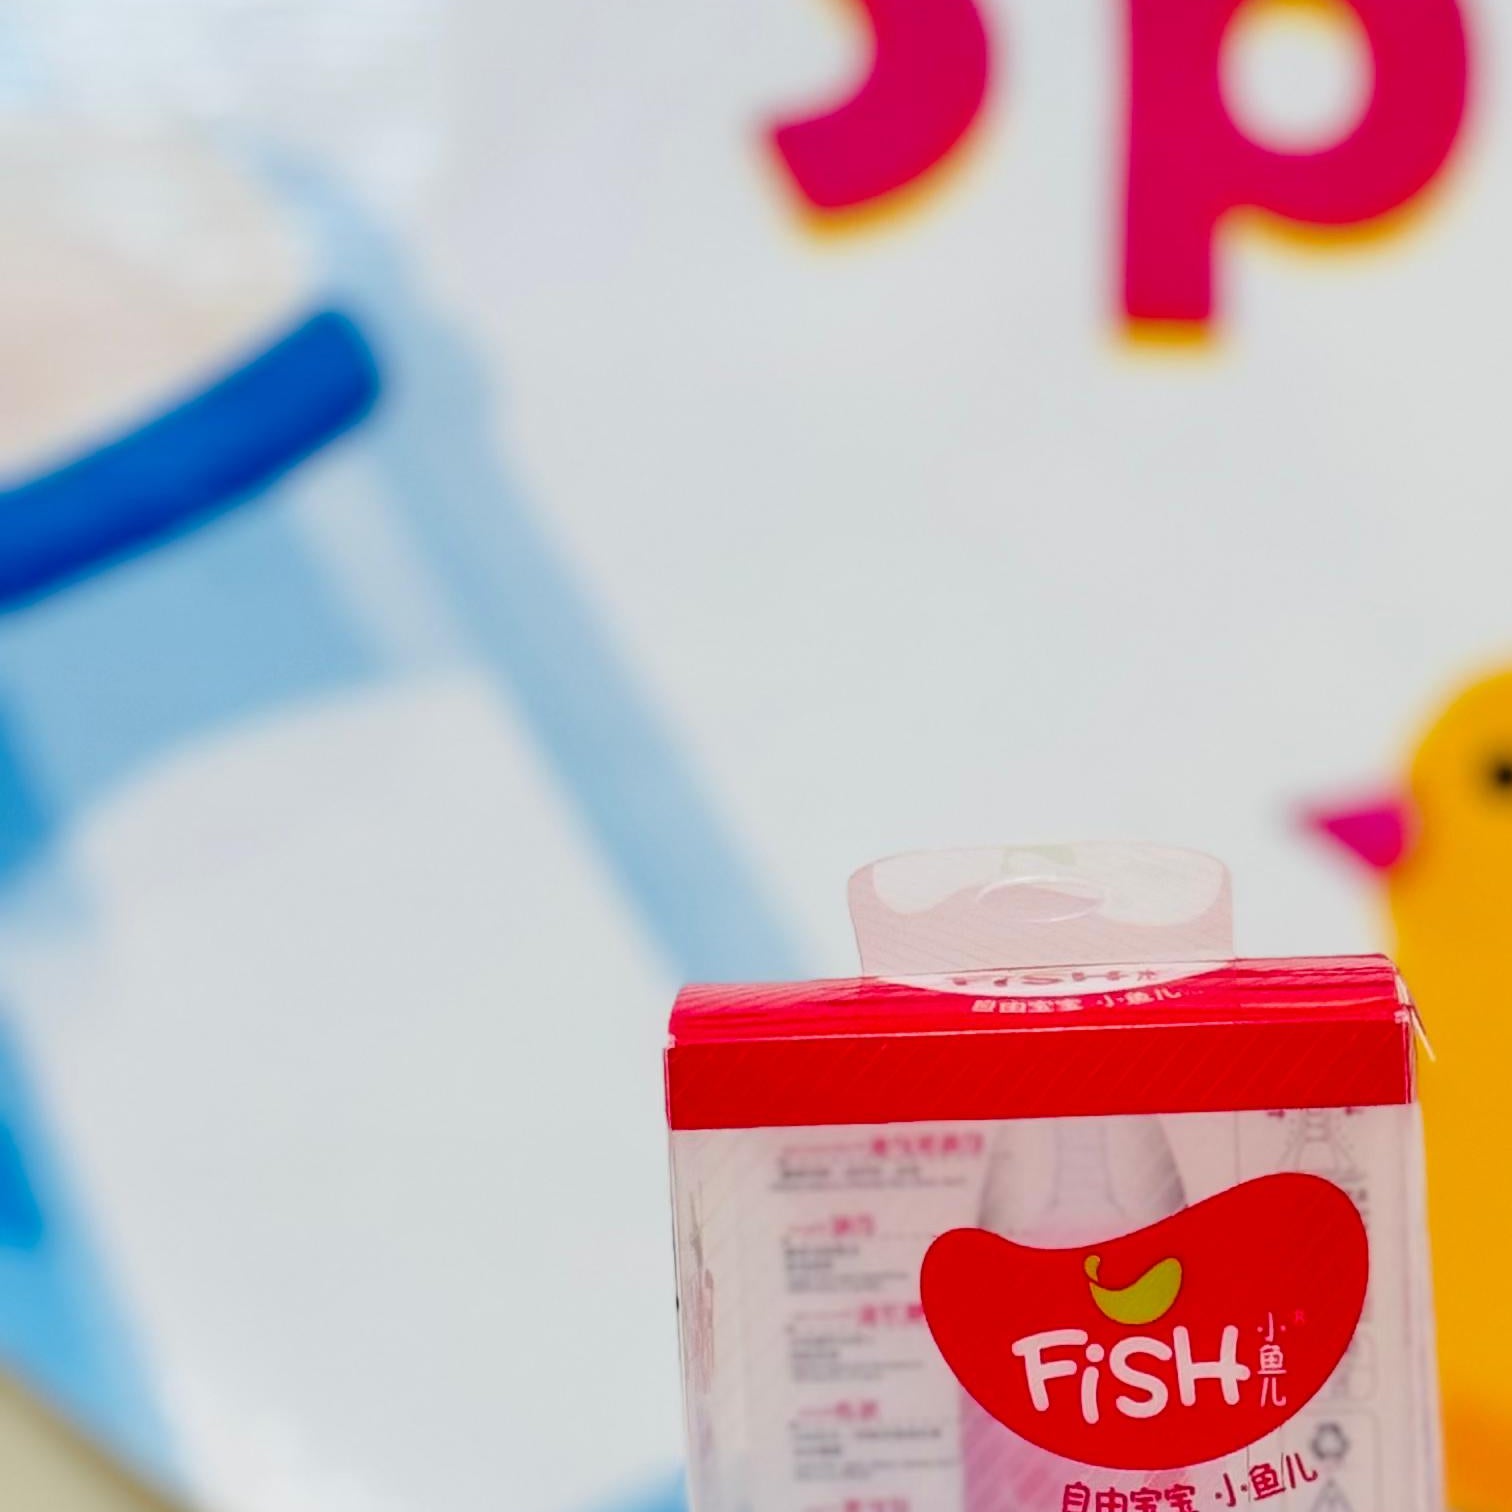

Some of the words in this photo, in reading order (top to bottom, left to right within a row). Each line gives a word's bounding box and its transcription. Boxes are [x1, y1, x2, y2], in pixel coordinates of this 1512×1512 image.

[1256, 1311, 1287, 1408] 小鱼儿
[1214, 1452, 1318, 1508] 小鱼儿
